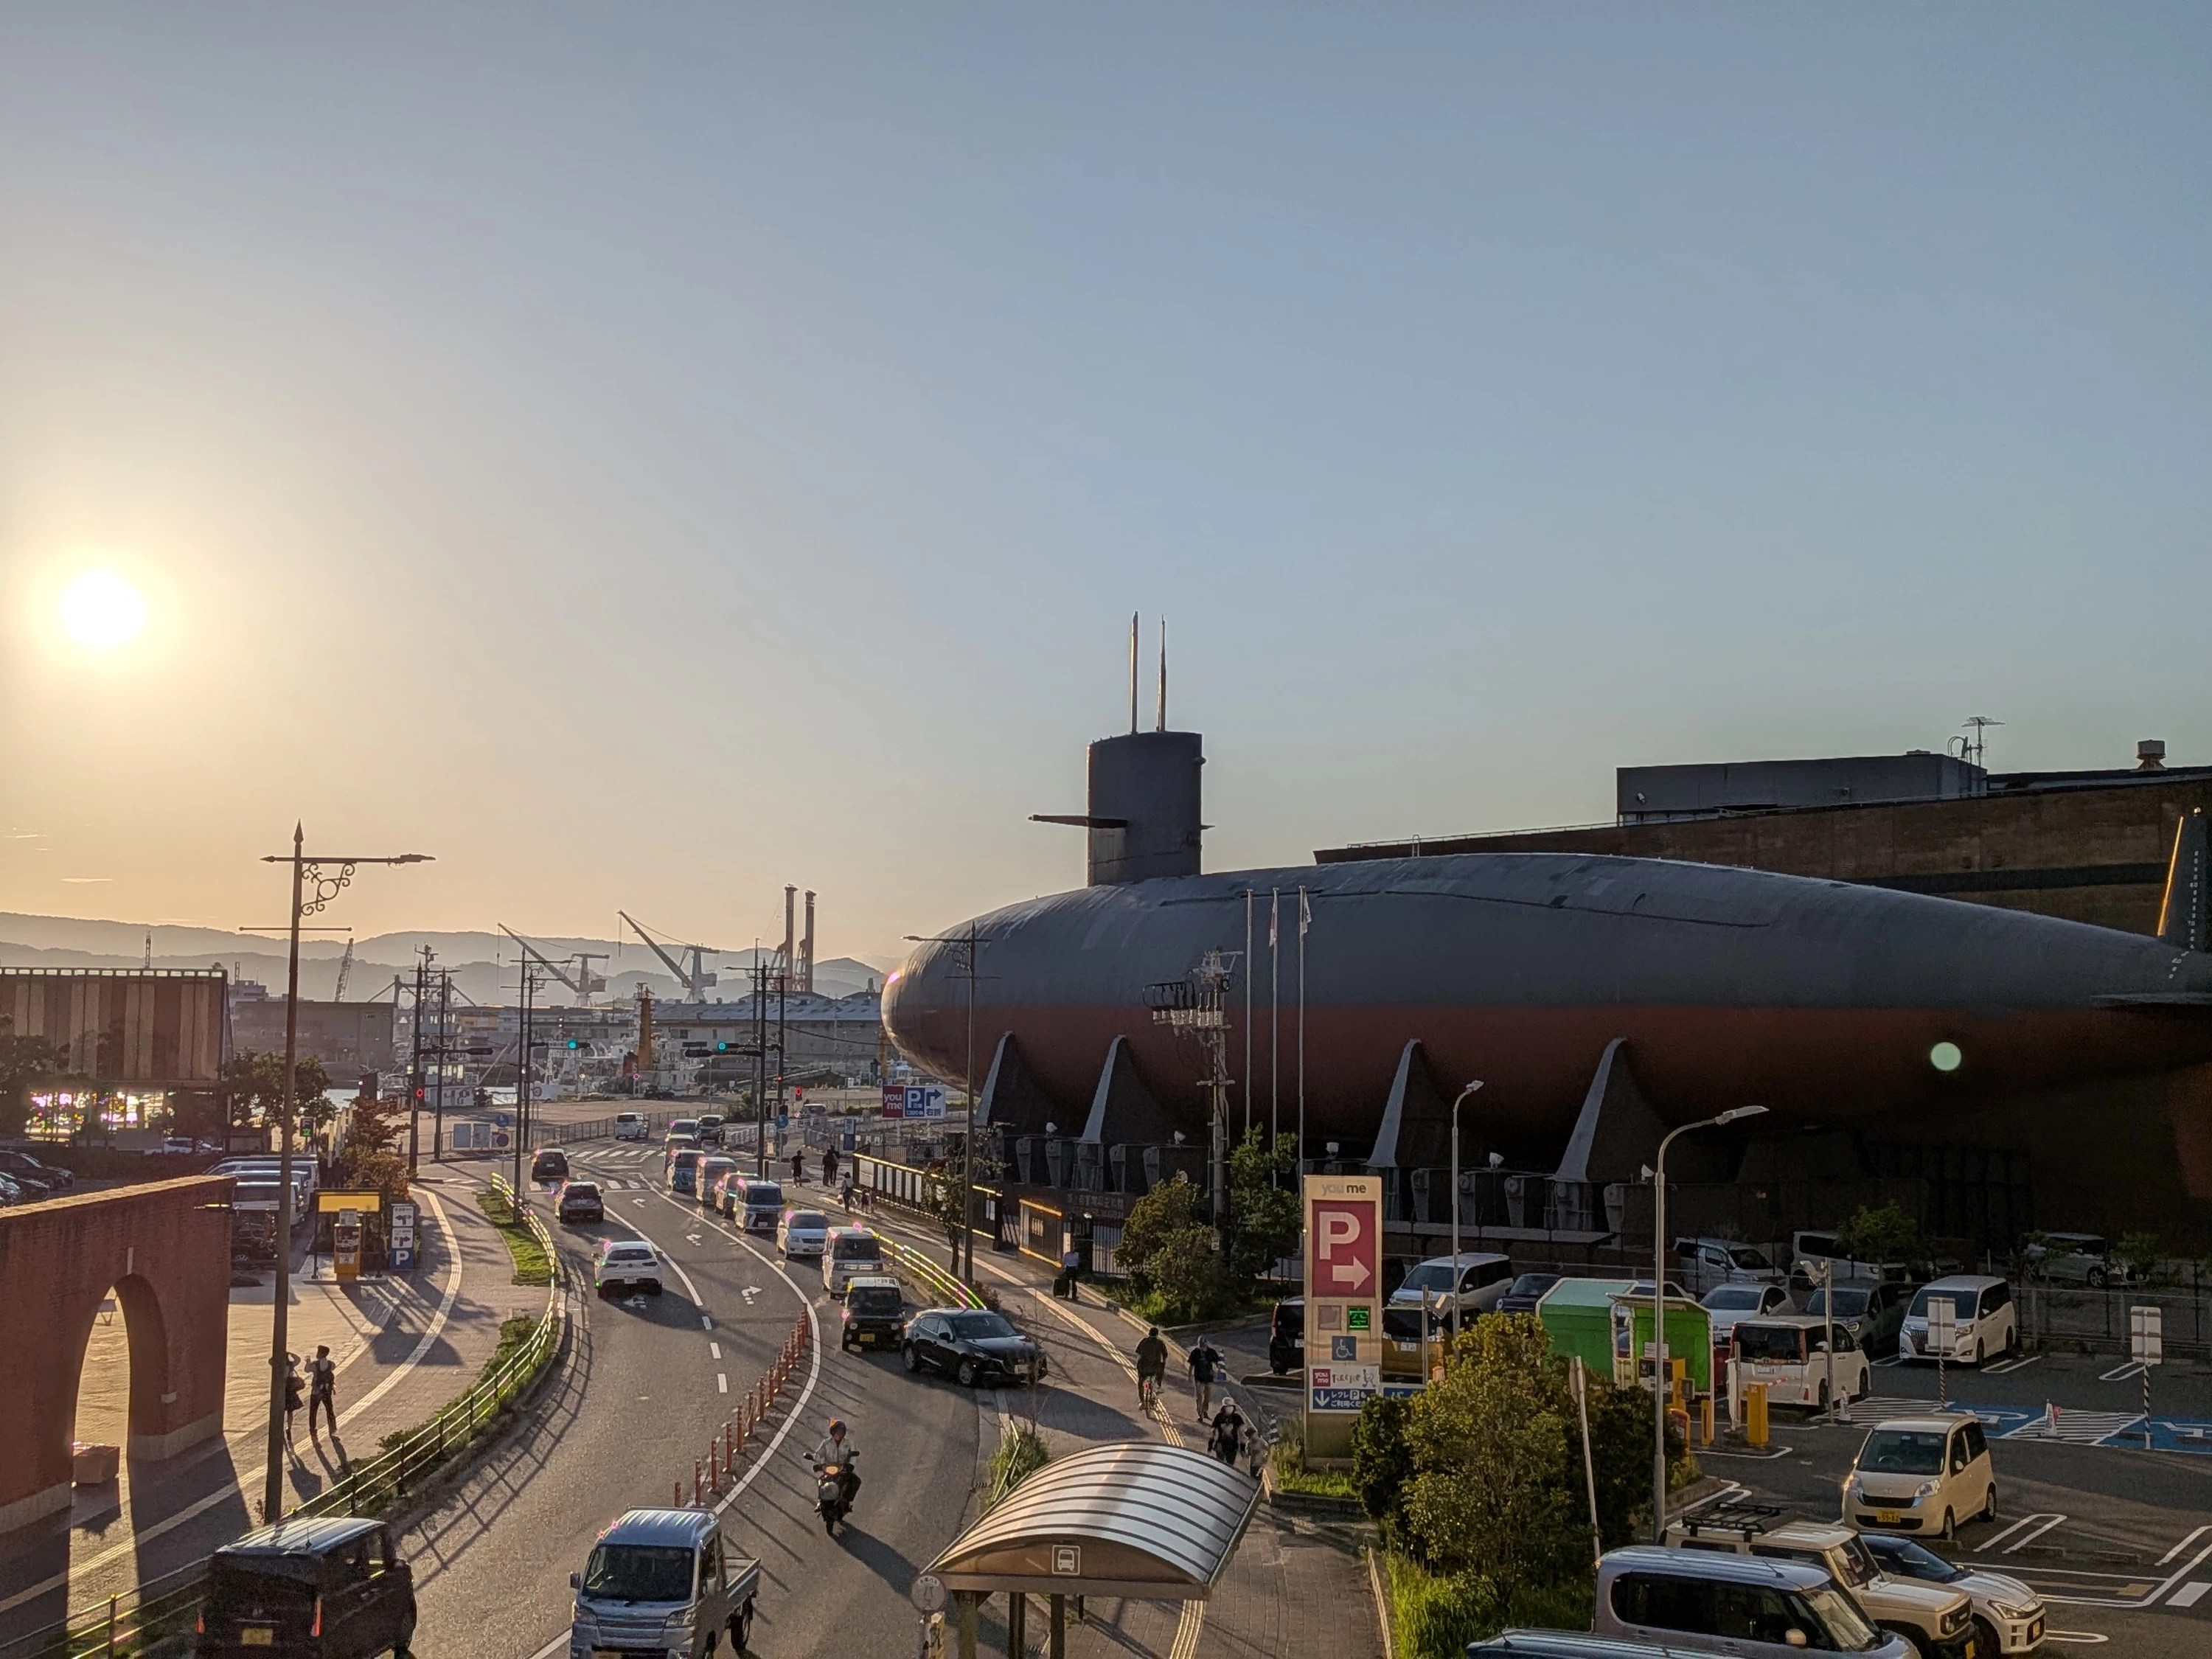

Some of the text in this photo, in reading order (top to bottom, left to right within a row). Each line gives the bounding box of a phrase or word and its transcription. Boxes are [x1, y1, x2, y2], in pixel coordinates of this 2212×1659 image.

[883, 1093, 902, 1103] you
[907, 1090, 921, 1109] P
[1319, 1211, 1360, 1259] P
[395, 1251, 409, 1265] P
